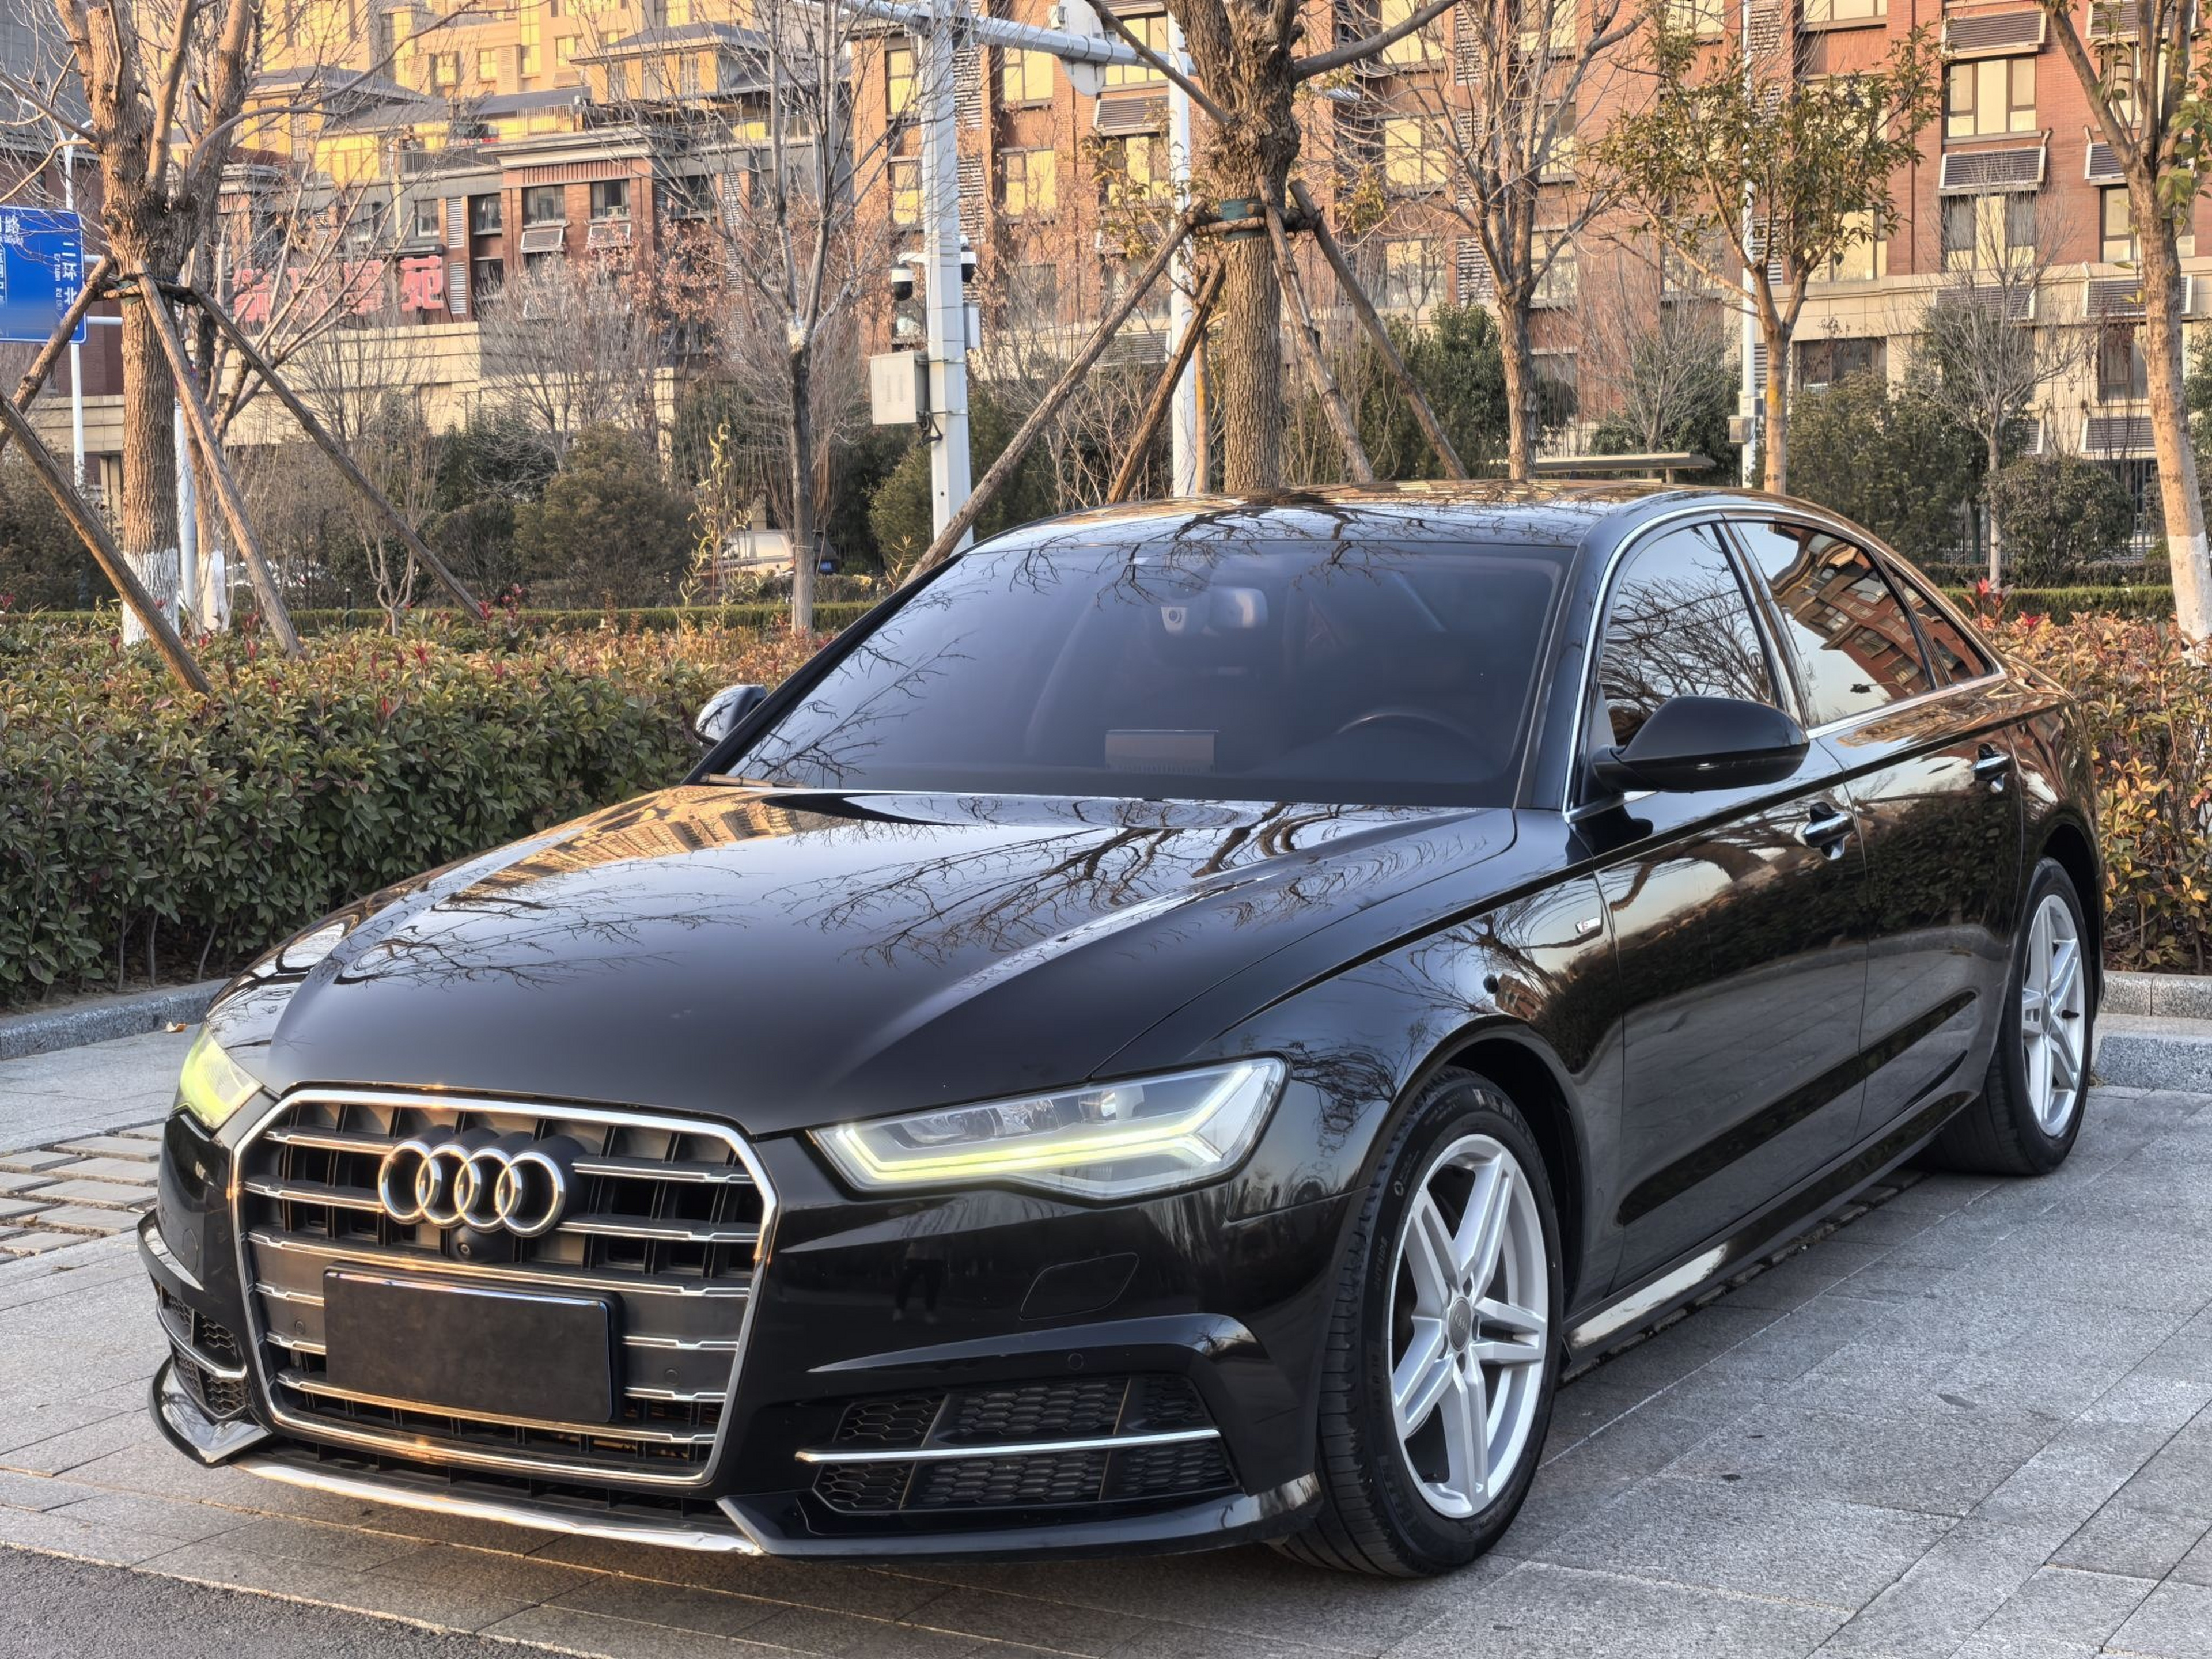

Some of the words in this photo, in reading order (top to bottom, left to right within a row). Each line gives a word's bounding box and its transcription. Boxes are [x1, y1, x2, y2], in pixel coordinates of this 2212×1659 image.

[56, 287, 62, 298] Rd
[62, 241, 78, 331] 二环北
